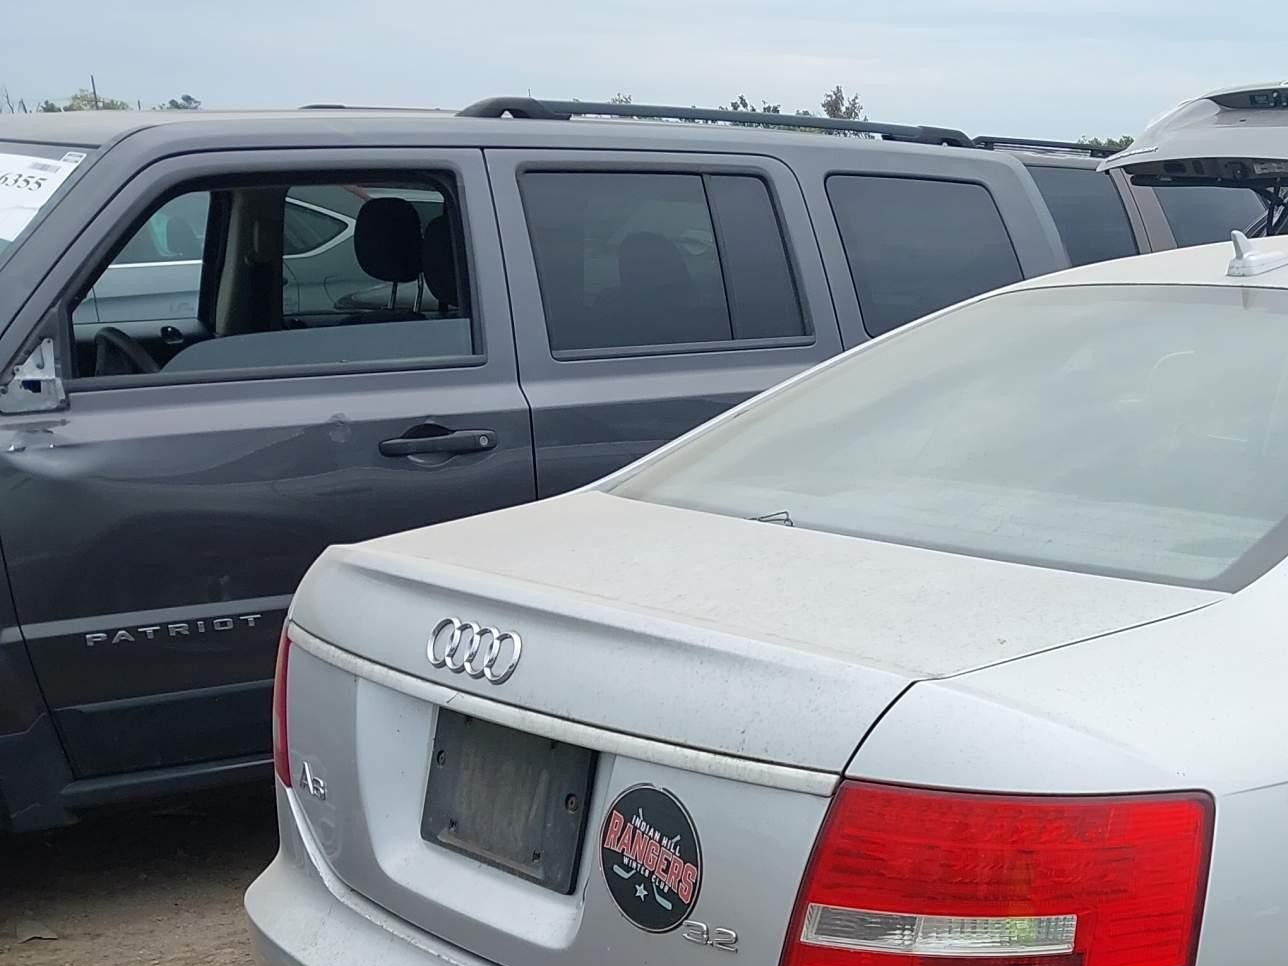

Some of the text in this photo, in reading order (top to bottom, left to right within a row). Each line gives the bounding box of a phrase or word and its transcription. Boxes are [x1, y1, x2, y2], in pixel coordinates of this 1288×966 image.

[86, 614, 262, 646] PATRIOT
[632, 815, 681, 856] INDIAN HILL
[604, 809, 698, 904] RANGERS
[623, 856, 670, 894] WINTER CLUB
[682, 920, 739, 954] 3.2
